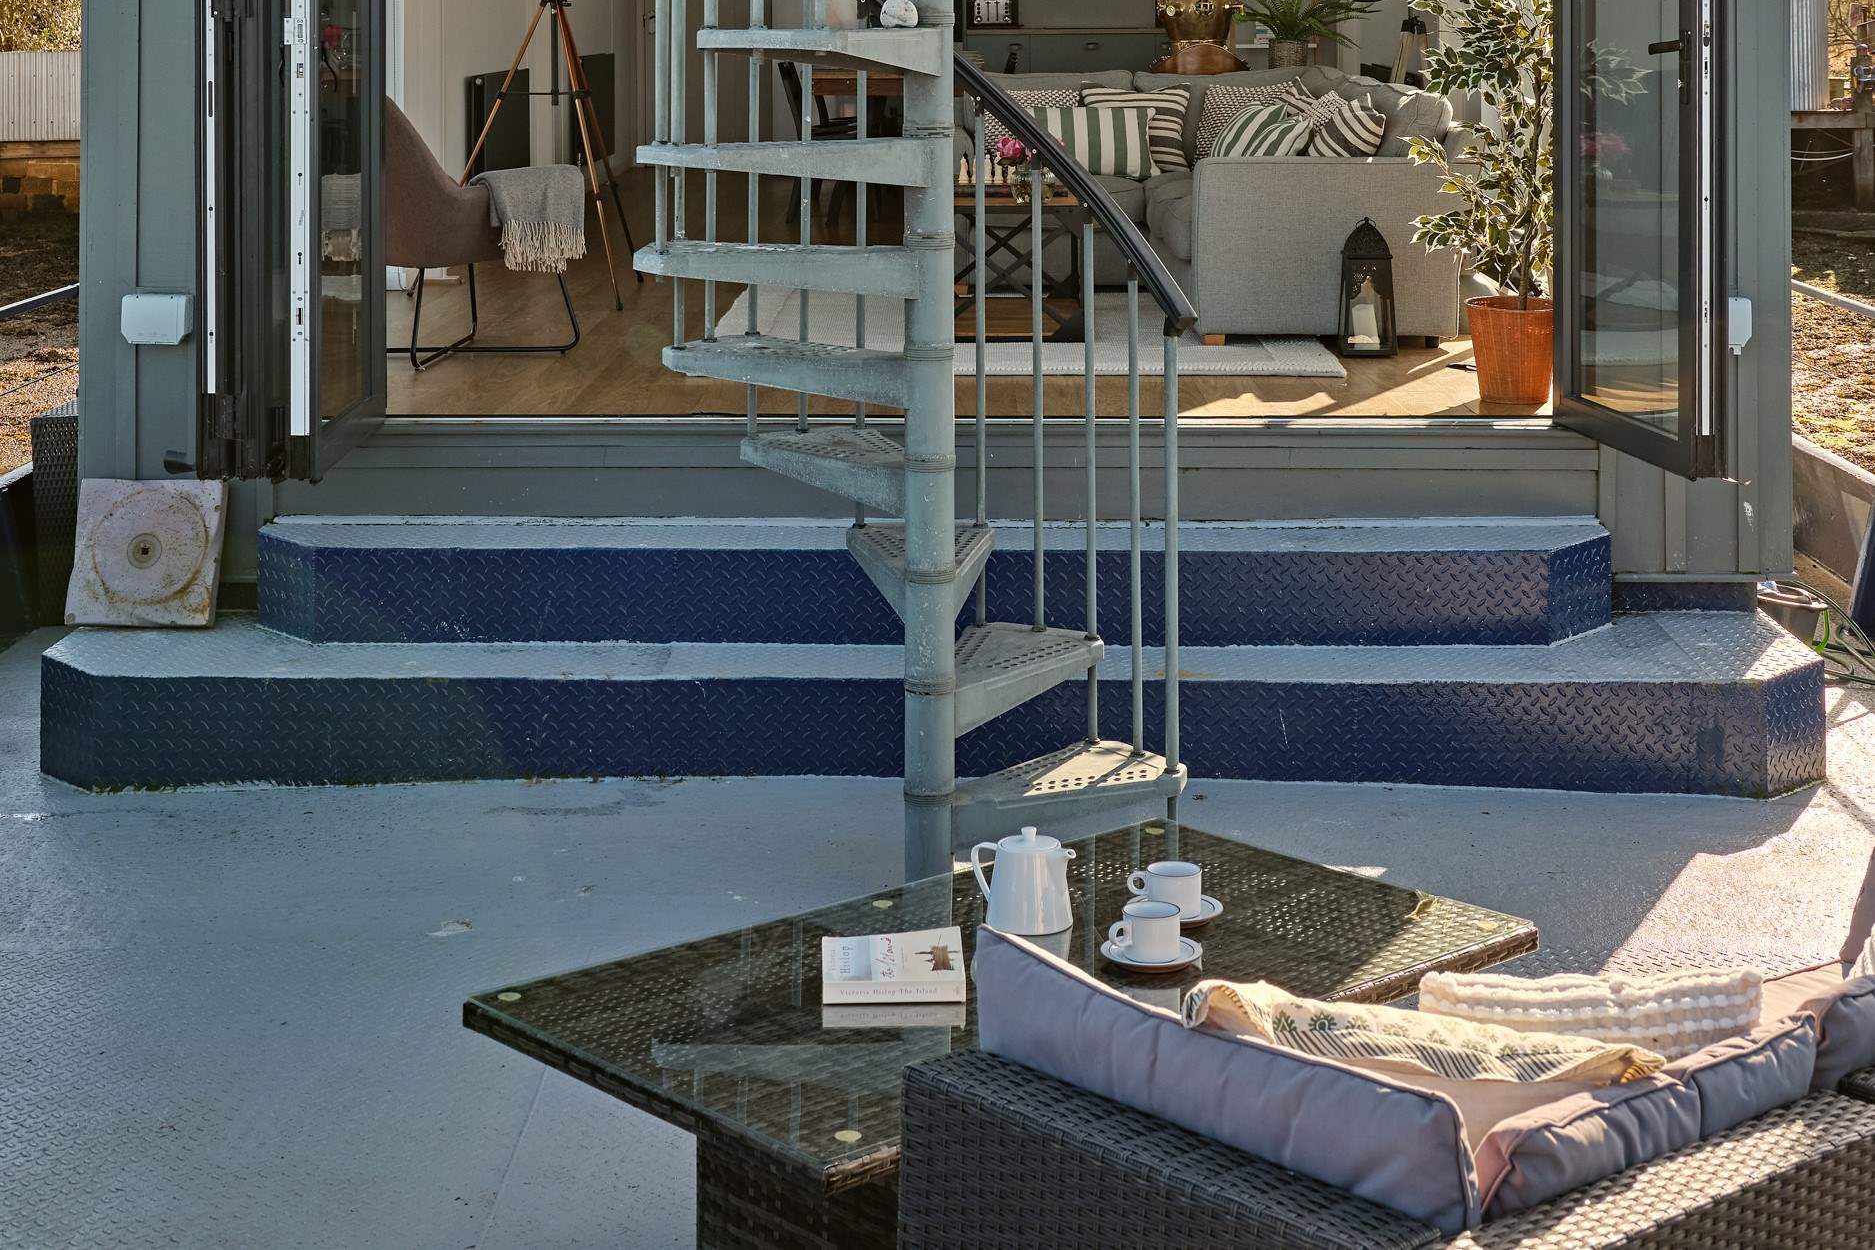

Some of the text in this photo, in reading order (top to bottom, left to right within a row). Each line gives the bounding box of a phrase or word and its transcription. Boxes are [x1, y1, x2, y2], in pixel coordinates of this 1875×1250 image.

[840, 945, 853, 974] Hislop
[873, 988, 896, 996] Hislop
[916, 987, 937, 995] Island
